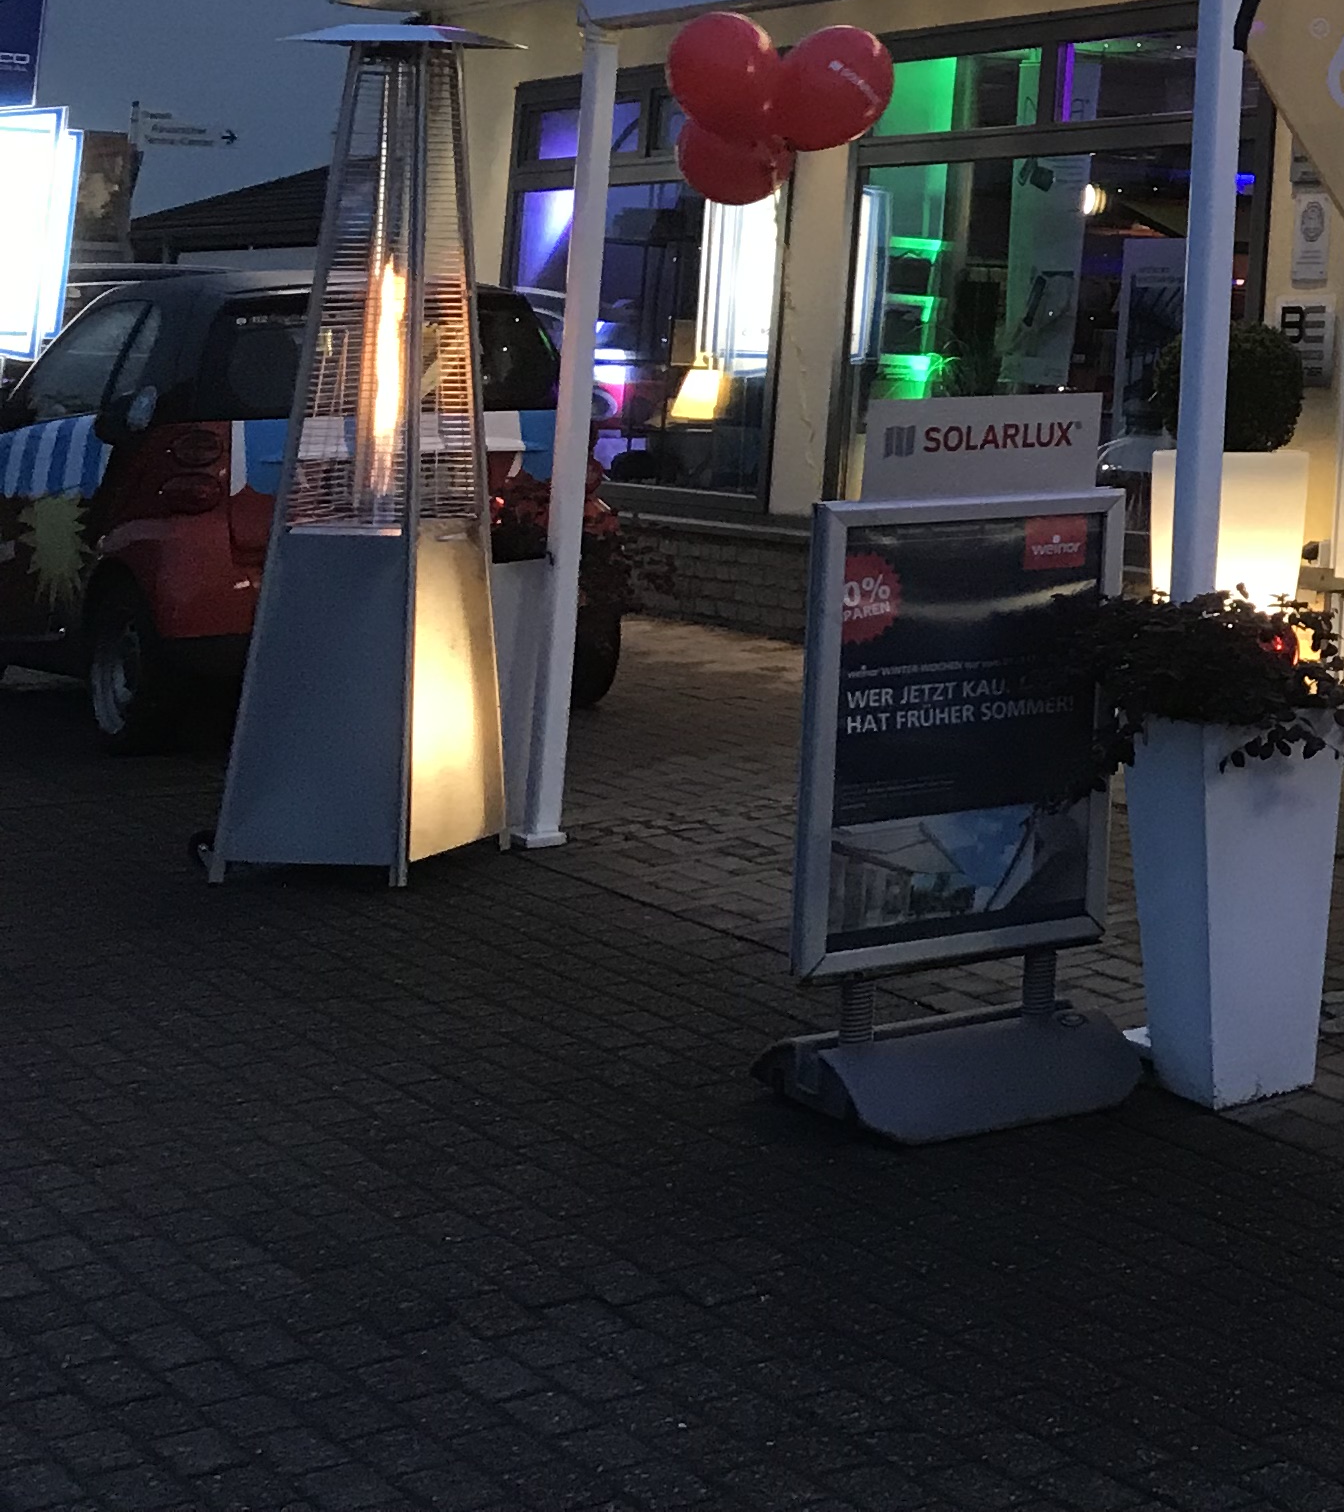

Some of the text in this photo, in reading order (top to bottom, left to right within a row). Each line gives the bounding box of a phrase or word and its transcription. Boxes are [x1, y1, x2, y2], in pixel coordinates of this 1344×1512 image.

[923, 421, 1074, 453] SOLARLUX
[1031, 534, 1082, 557] weinor
[847, 688, 894, 709] WER
[900, 682, 957, 704] JETZT
[846, 695, 1075, 734] HAT FRÜHER SOMMER!
